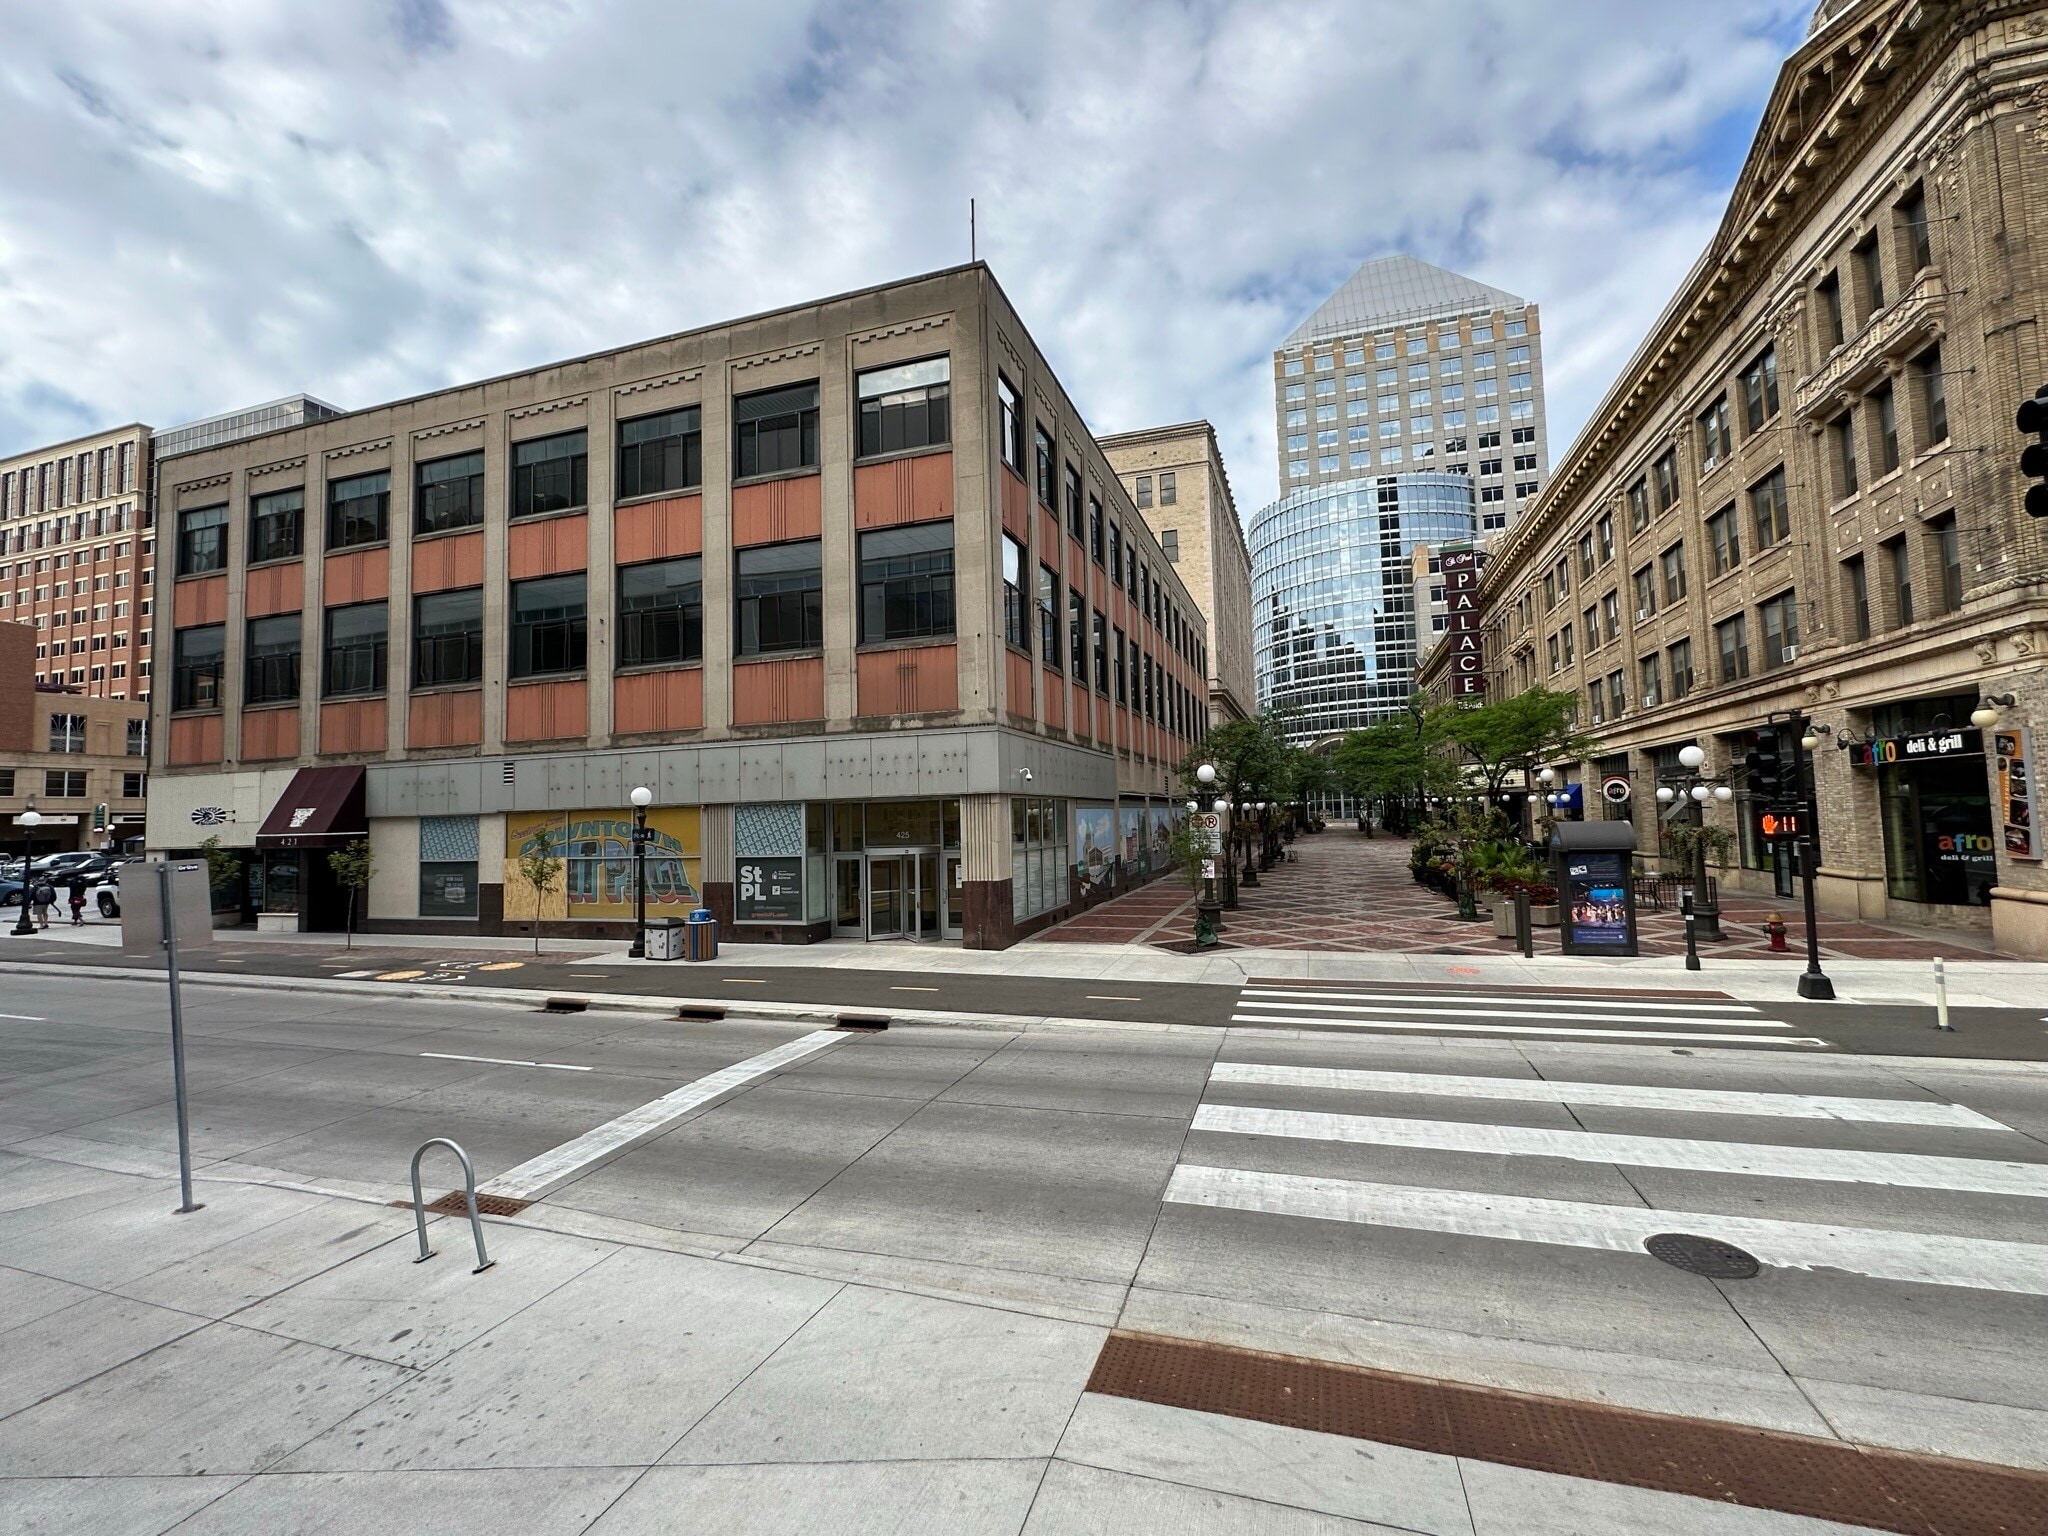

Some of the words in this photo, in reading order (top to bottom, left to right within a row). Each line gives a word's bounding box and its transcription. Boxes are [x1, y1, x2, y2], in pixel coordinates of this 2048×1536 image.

[1456, 572, 1476, 693] PALACE
[1863, 739, 1896, 766] afro
[1906, 739, 1926, 753] deli
[1927, 737, 1937, 751] &
[1938, 734, 1963, 753] grill
[1782, 816, 1796, 832] 11
[280, 838, 298, 846] 421
[896, 831, 910, 839] 425
[1938, 833, 1993, 852] afro
[740, 865, 763, 883] St
[740, 883, 767, 900] PL
